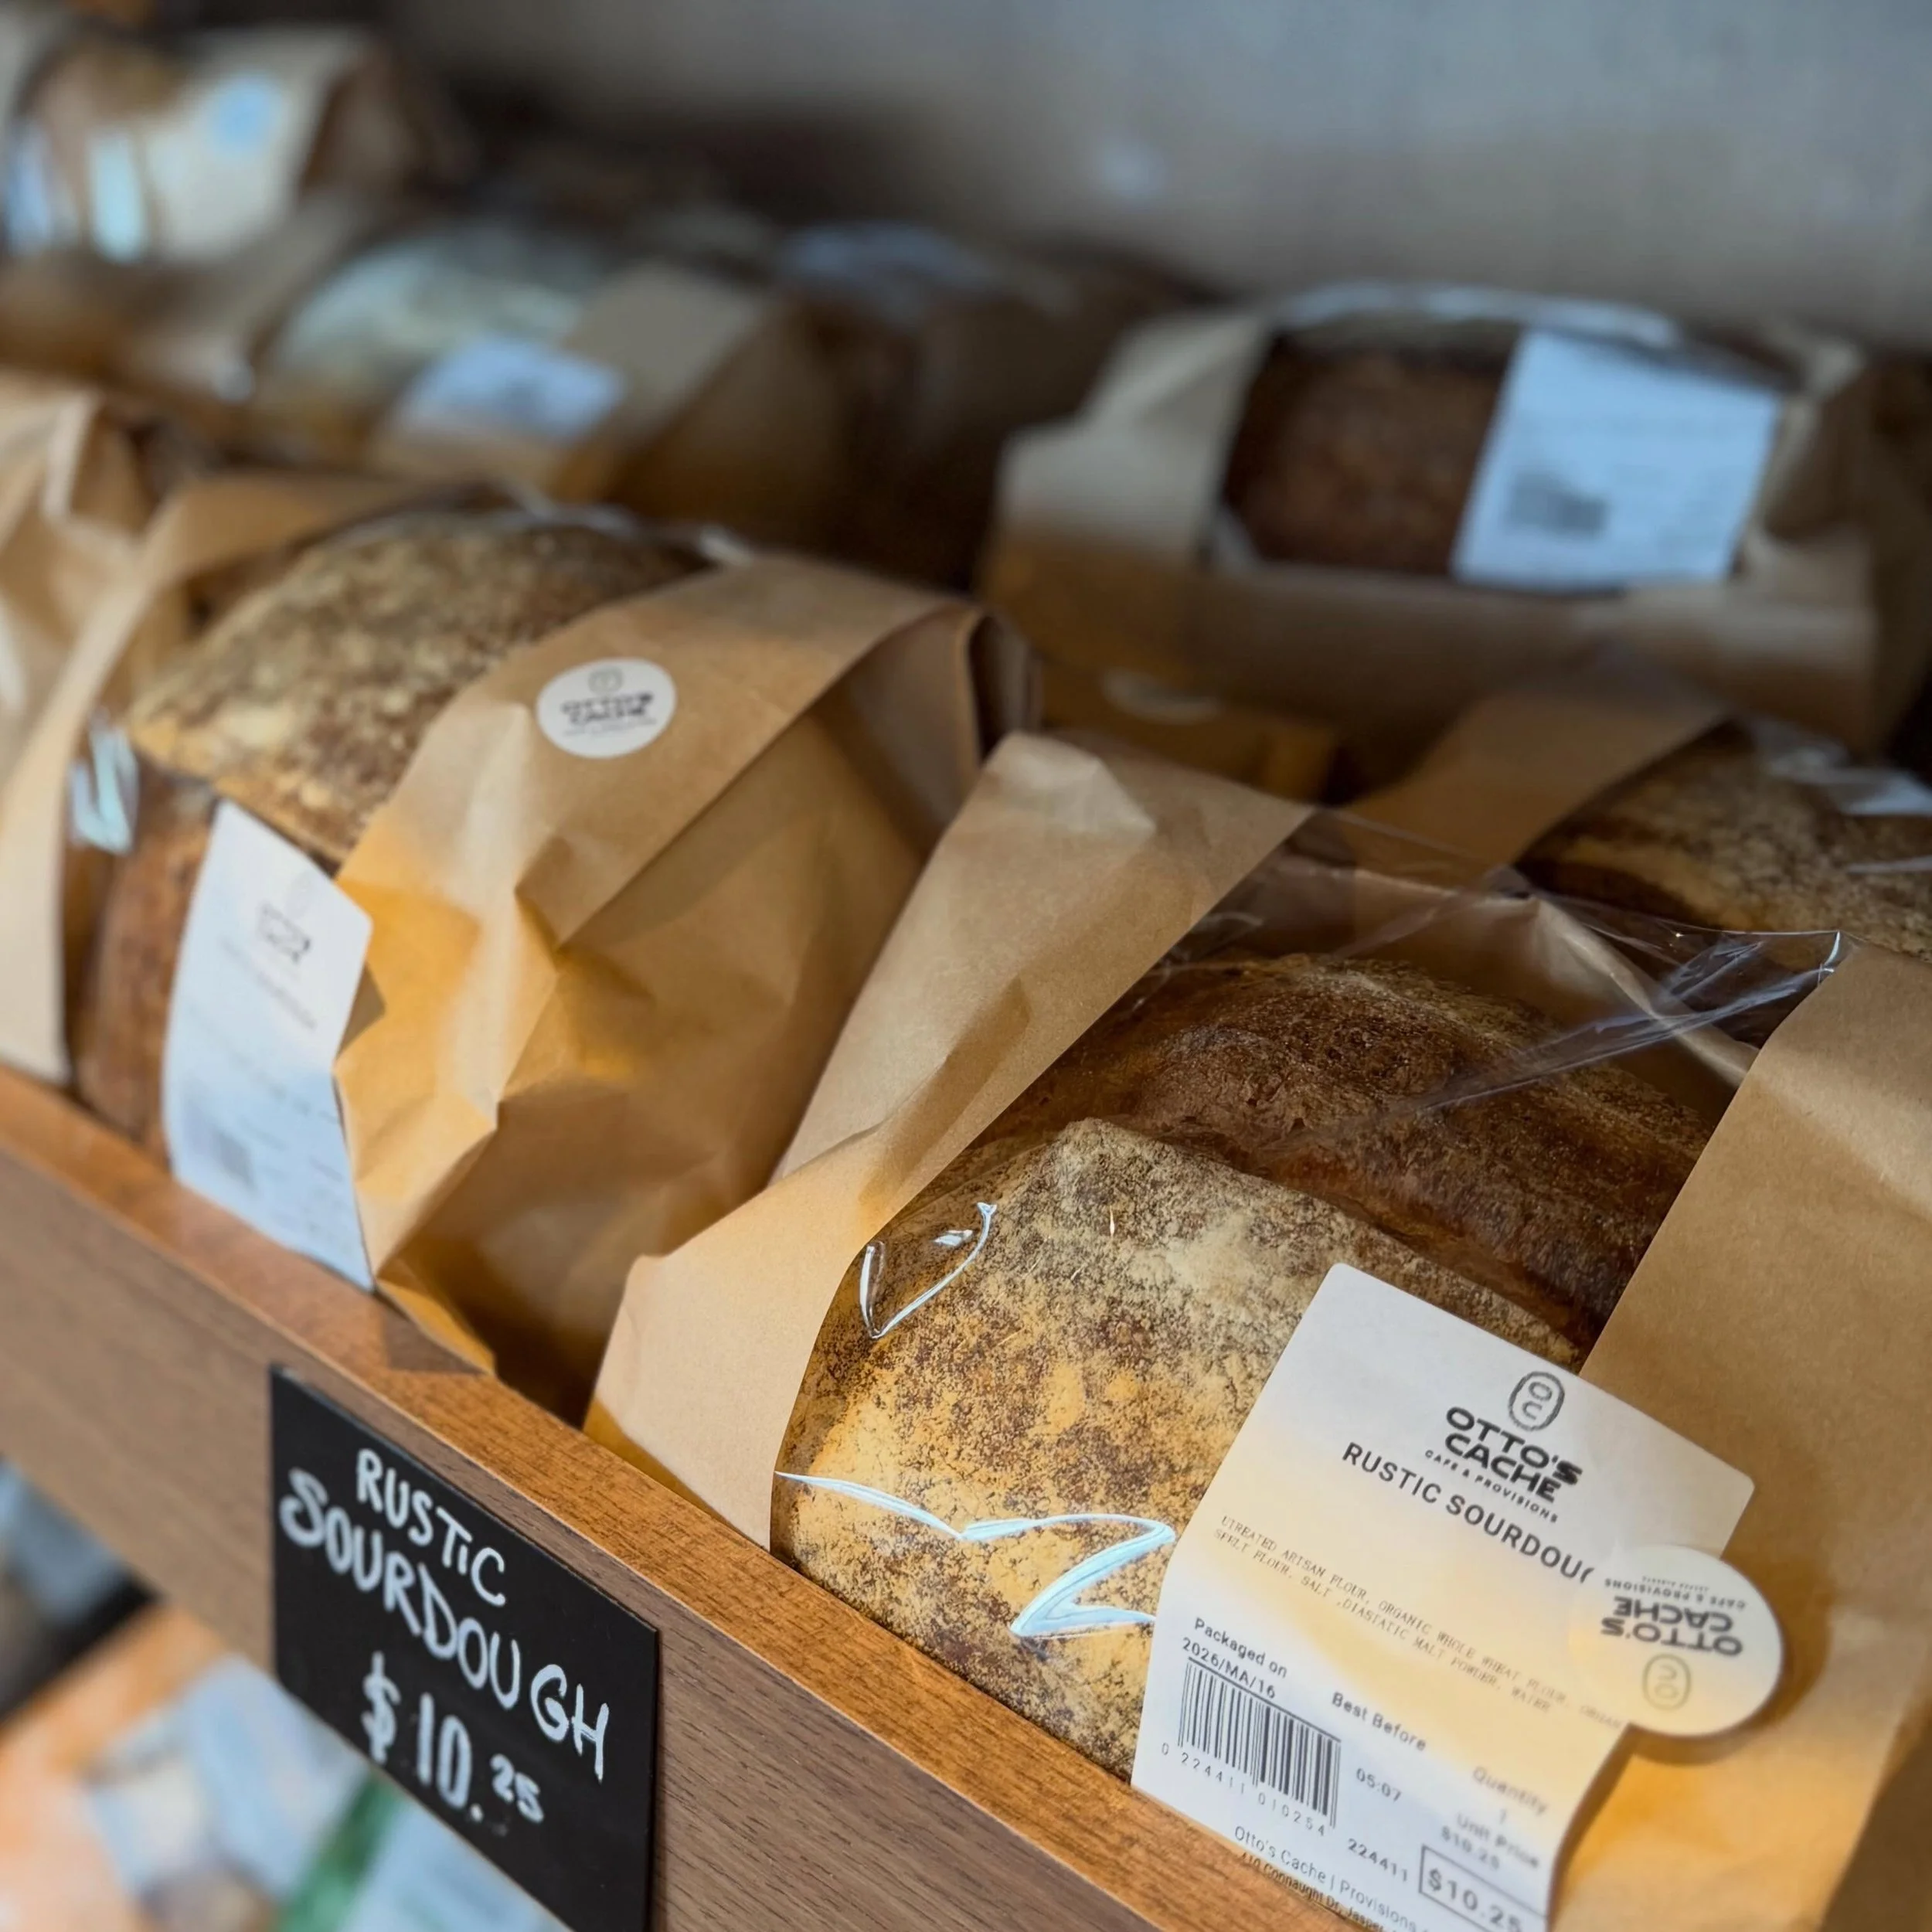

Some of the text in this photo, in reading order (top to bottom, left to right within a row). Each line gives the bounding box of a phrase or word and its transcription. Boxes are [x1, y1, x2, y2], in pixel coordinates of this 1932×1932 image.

[1444, 1433, 1562, 1503] CACHE
[1446, 1406, 1583, 1485] OTTO'S
[1342, 1442, 1595, 1583] RUSTIC SOURDOU
[1425, 1450, 1458, 1471] CAFE
[1475, 1475, 1558, 1523] PROVISIONS
[279, 1468, 609, 1783] SOURDOUGH
[1379, 1600, 1433, 1634] ORGANIC
[1437, 1631, 1477, 1659] WHOLE
[1600, 1617, 1743, 1657] OTTO'S
[1612, 1595, 1734, 1633] CACHE
[1182, 1636, 1276, 1699] 2026/MA/16
[1195, 1617, 1288, 1679] Packaged on
[1413, 1636, 1446, 1661] MALT
[1332, 1692, 1427, 1751] Best Before
[1473, 1766, 1549, 1815] Quantity
[1234, 1825, 1277, 1859] Otto's
[1281, 1849, 1327, 1884] Cache
[1340, 1879, 1417, 1932] Provisions
[1348, 1837, 1409, 1883] 224411
